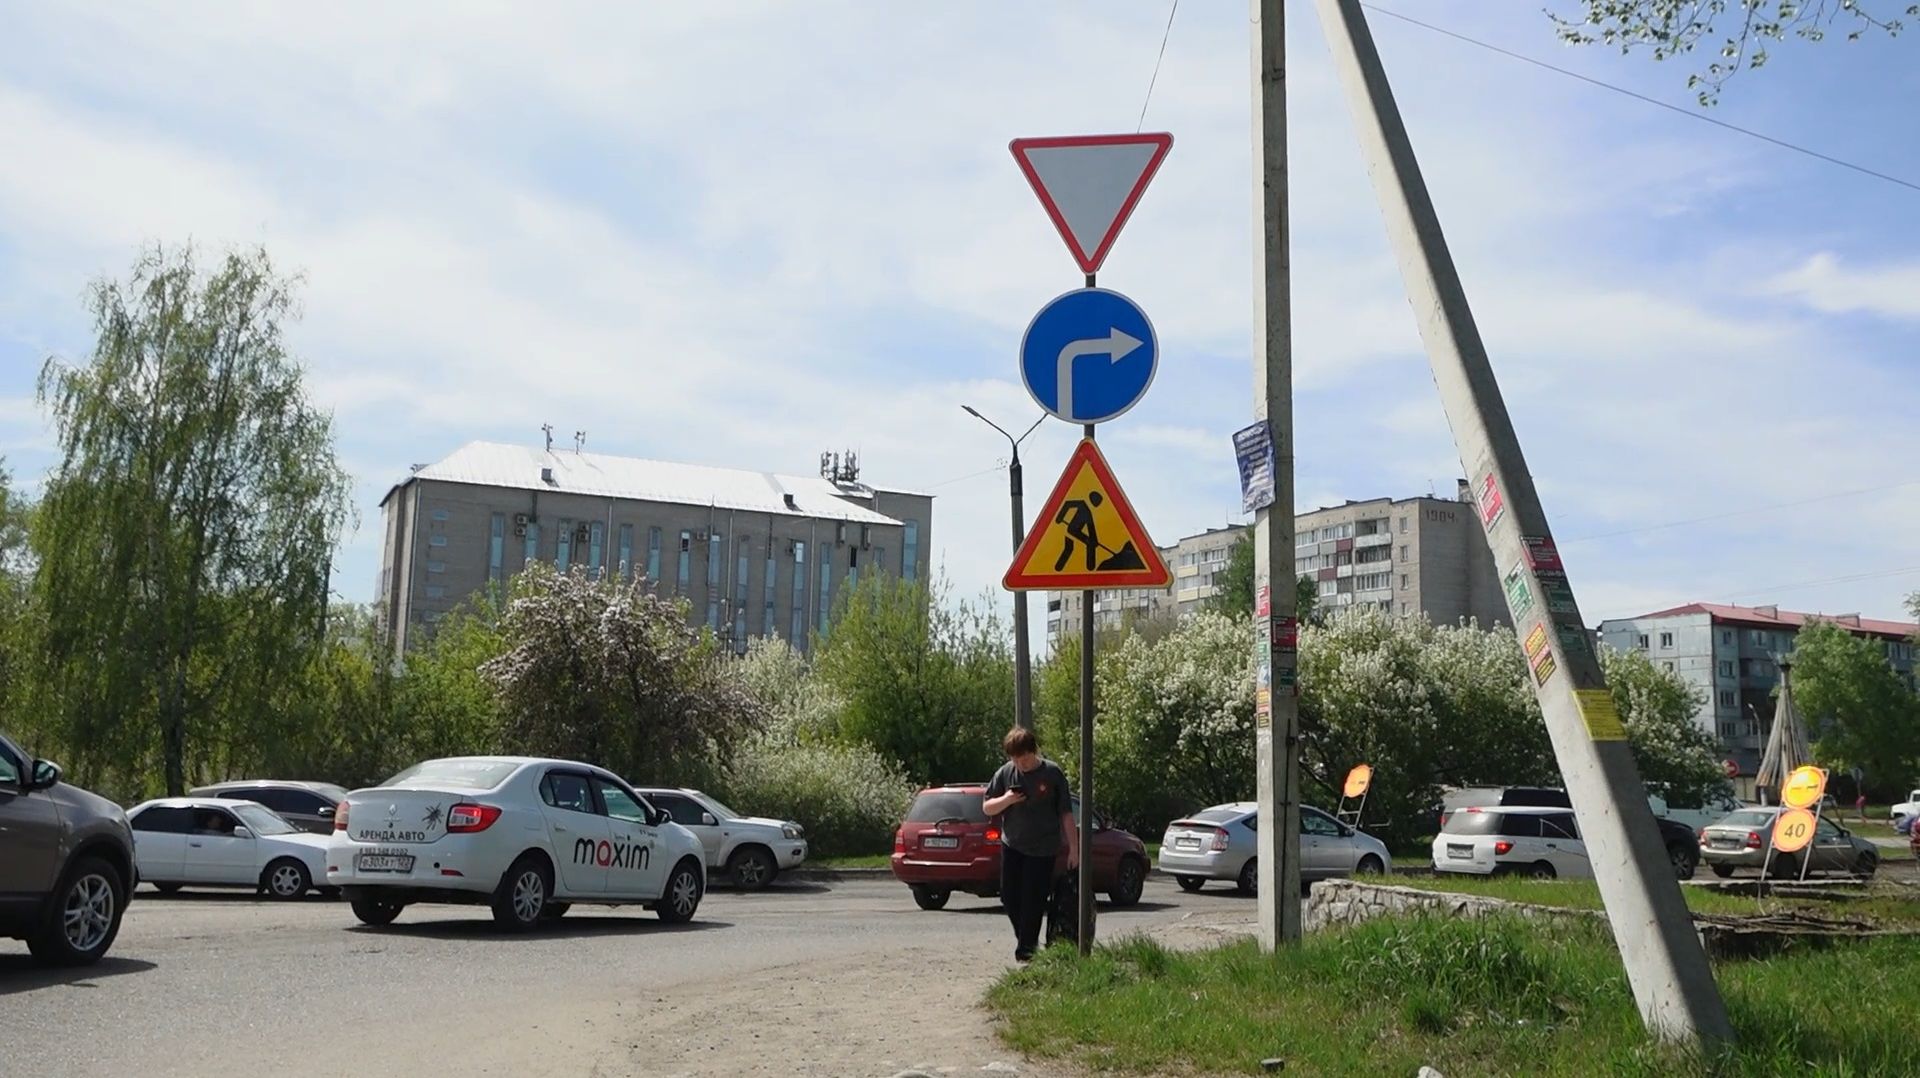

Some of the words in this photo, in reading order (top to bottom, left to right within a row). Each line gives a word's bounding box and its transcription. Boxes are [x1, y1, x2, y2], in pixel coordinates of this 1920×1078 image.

[360, 830, 396, 841] АРЕНДА
[398, 831, 426, 841] АВТО
[1784, 823, 1805, 838] 40
[574, 835, 650, 870] maxim
